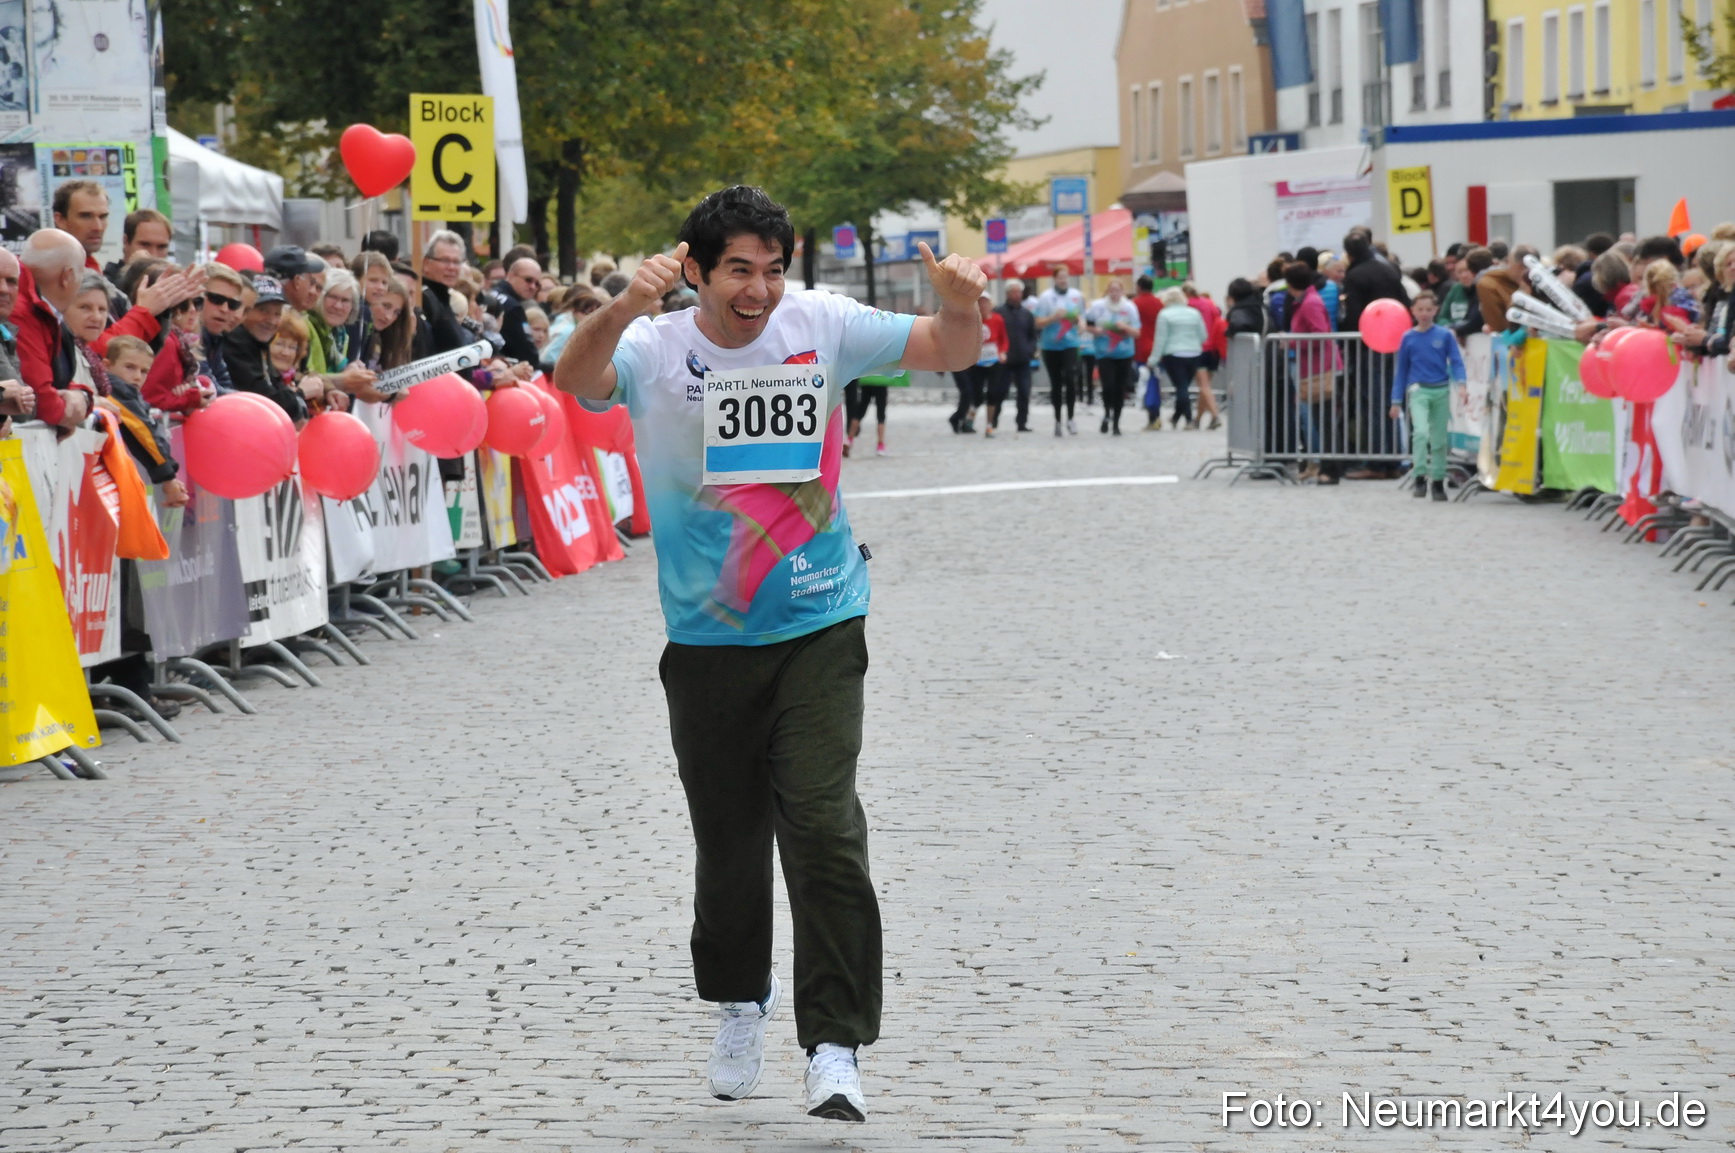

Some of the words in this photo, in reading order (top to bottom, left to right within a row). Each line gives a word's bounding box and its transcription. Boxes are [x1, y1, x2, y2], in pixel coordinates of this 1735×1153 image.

[421, 101, 484, 123] Block
[432, 133, 473, 194] C
[1392, 169, 1427, 184] Block
[1401, 187, 1423, 219] D
[422, 363, 451, 383] BMW
[686, 385, 704, 394] PA
[707, 380, 748, 392] PARTL
[751, 376, 808, 388] Neumarkt
[686, 394, 704, 402] Neu
[718, 393, 817, 439] 3083
[789, 552, 813, 573] 16.
[790, 566, 839, 586] Neumarkter
[790, 579, 834, 599] Stadtlauf
